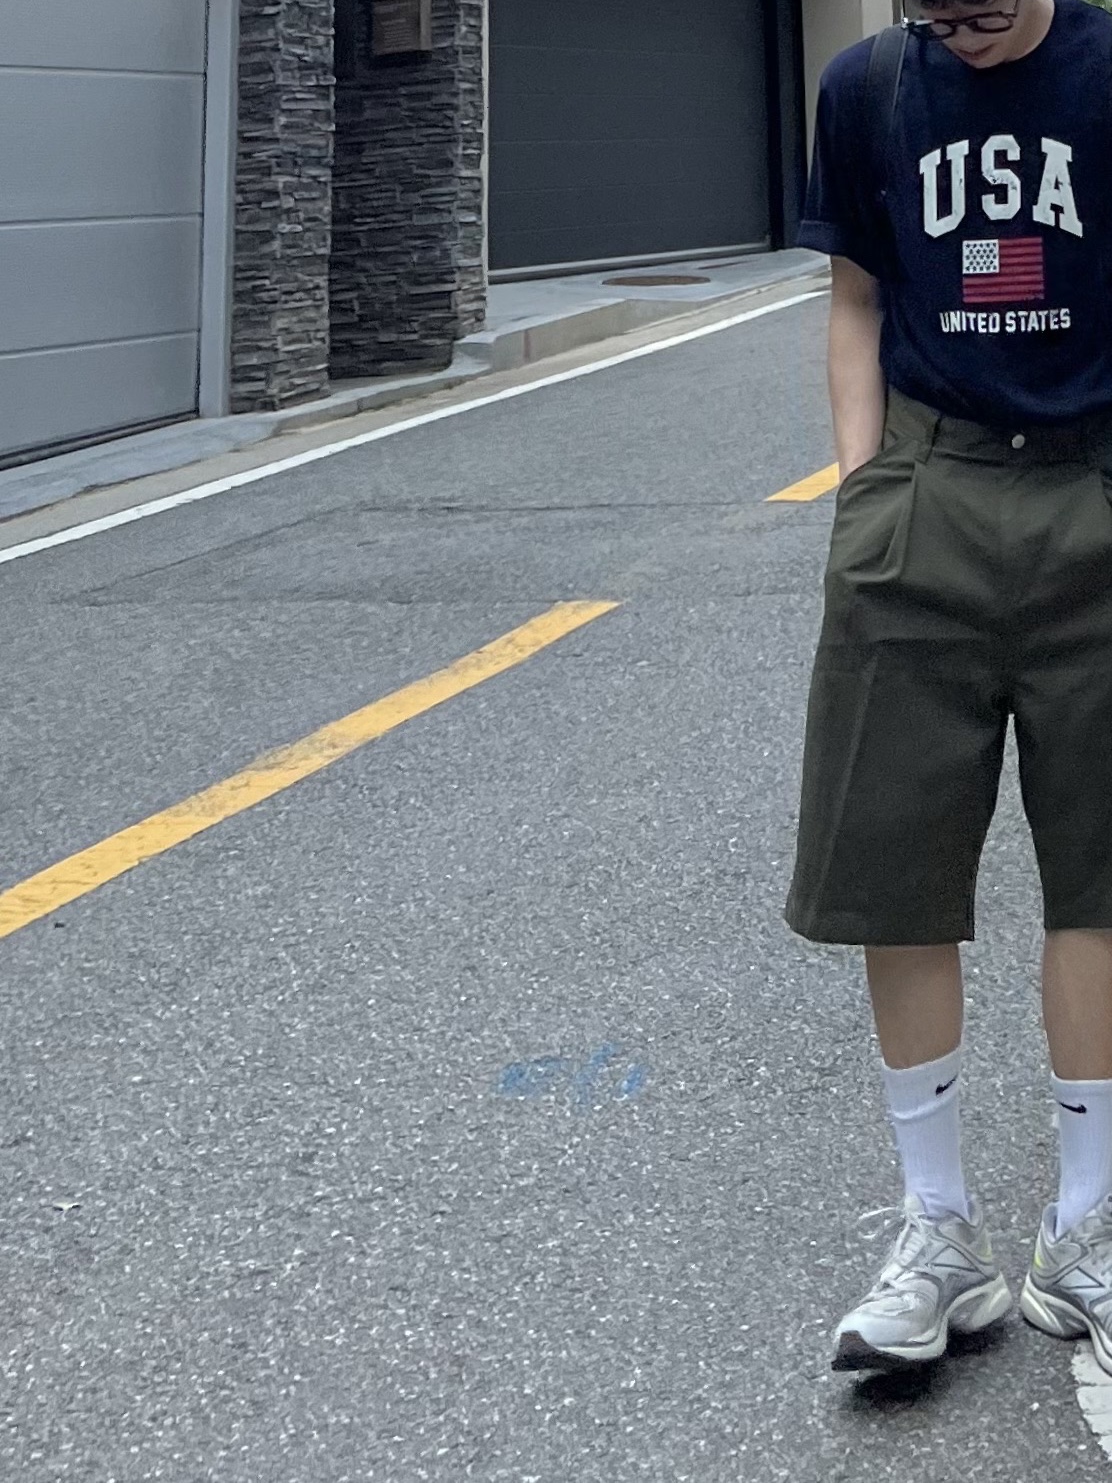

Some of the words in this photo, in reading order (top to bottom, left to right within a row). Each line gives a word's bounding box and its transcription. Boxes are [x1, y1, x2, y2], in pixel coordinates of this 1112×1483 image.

[919, 134, 1083, 239] USA
[939, 310, 1001, 334] UNITED
[1005, 307, 1071, 333] STATES
